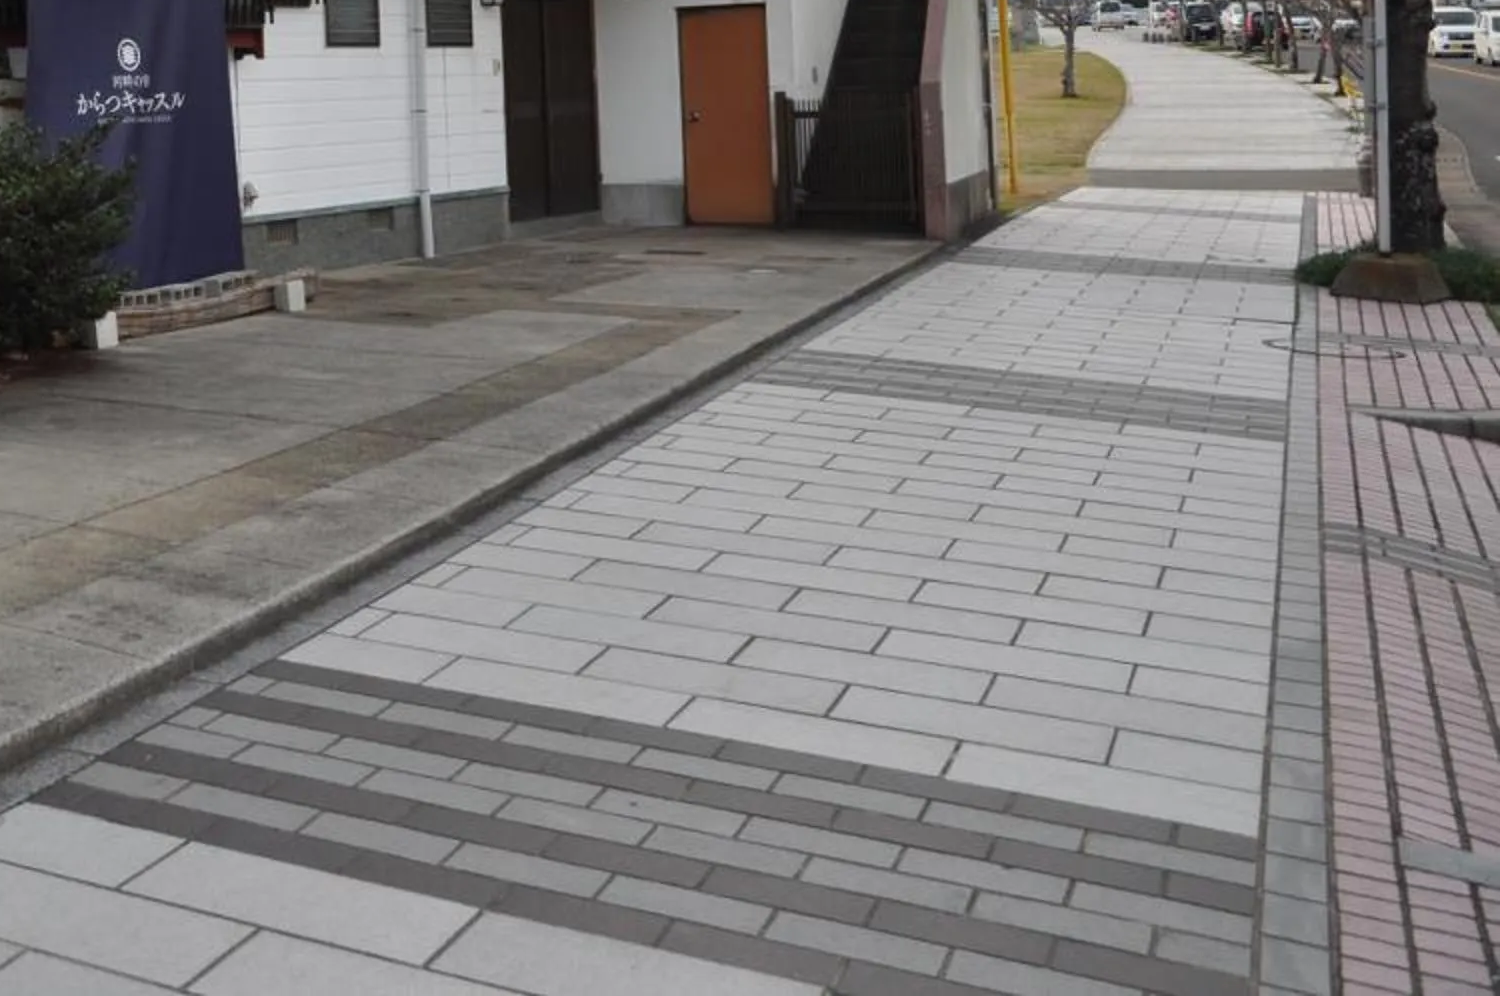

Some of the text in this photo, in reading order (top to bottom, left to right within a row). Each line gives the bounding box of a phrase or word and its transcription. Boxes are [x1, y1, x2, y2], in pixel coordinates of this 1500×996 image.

[76, 90, 187, 116] からつキャッスル
